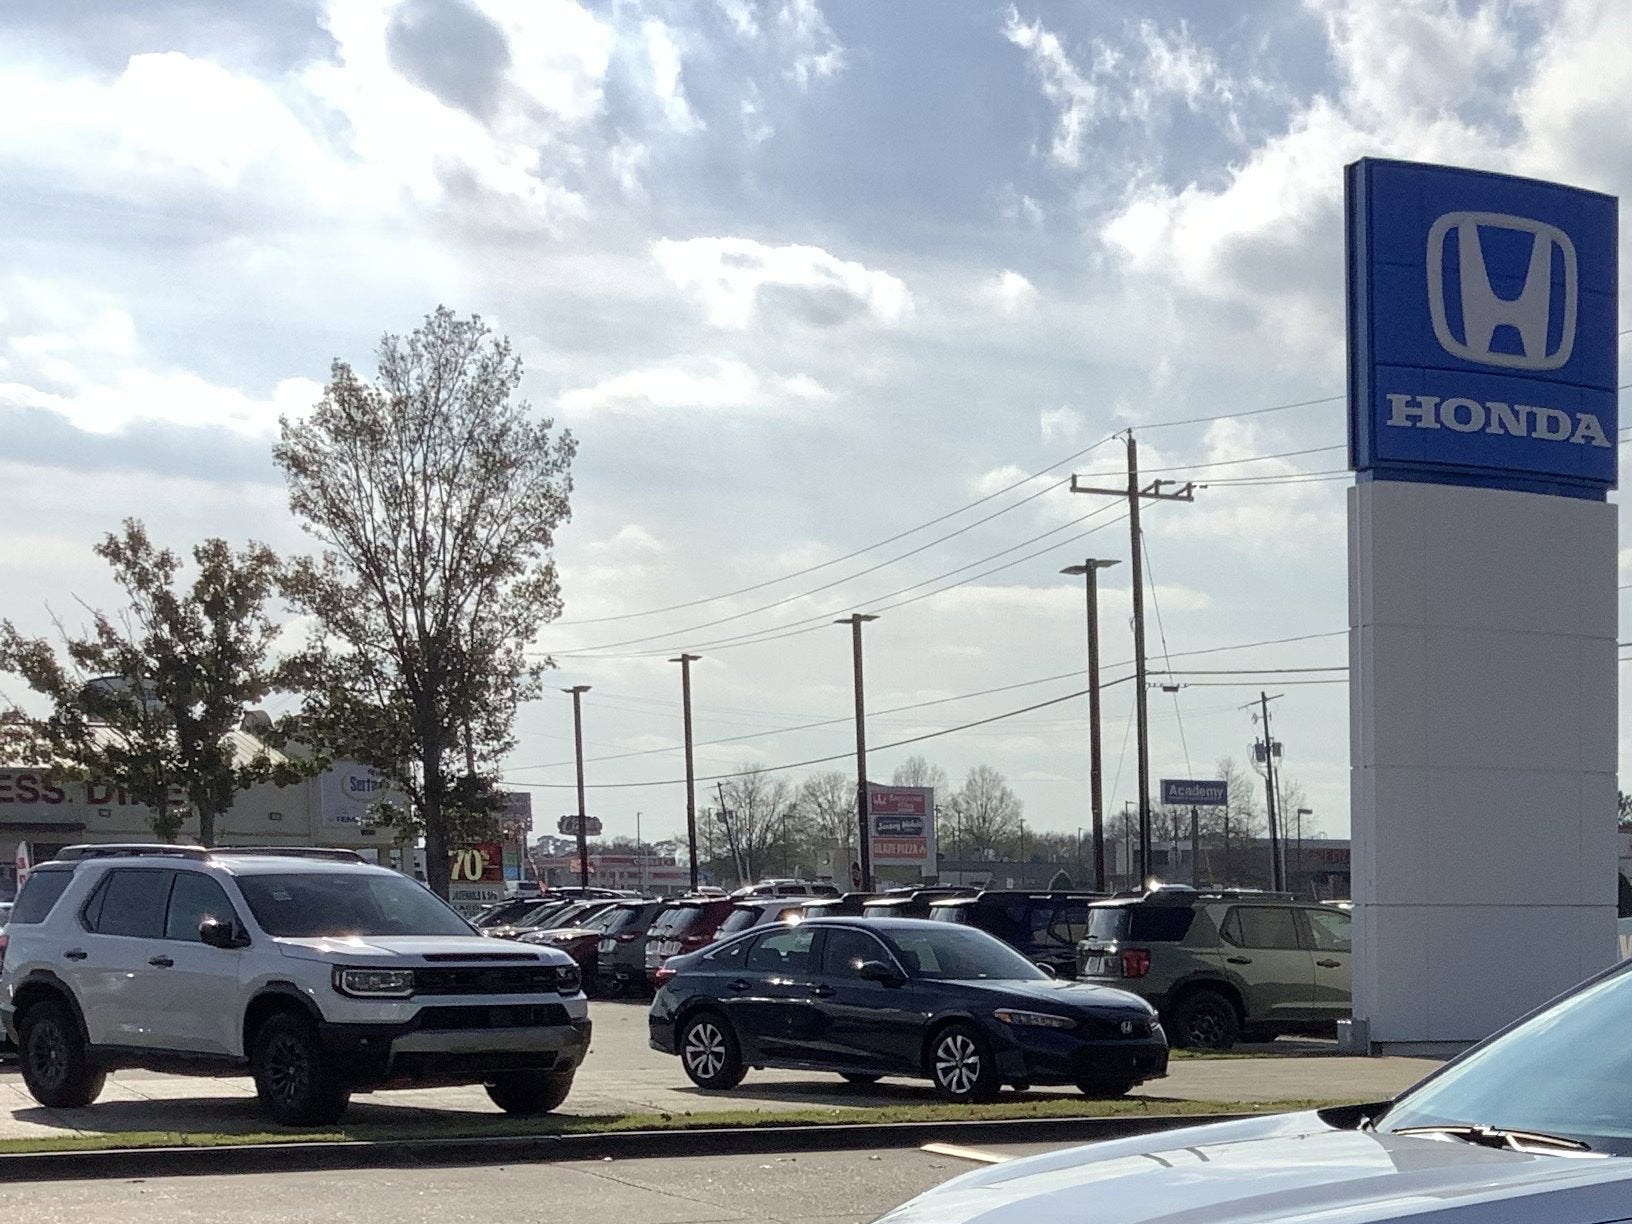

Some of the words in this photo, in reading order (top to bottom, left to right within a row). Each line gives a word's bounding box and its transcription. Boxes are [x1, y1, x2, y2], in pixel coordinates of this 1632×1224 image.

[1386, 393, 1611, 448] HONDA
[1168, 784, 1224, 801] Academy
[897, 843, 918, 855] PIZZA
